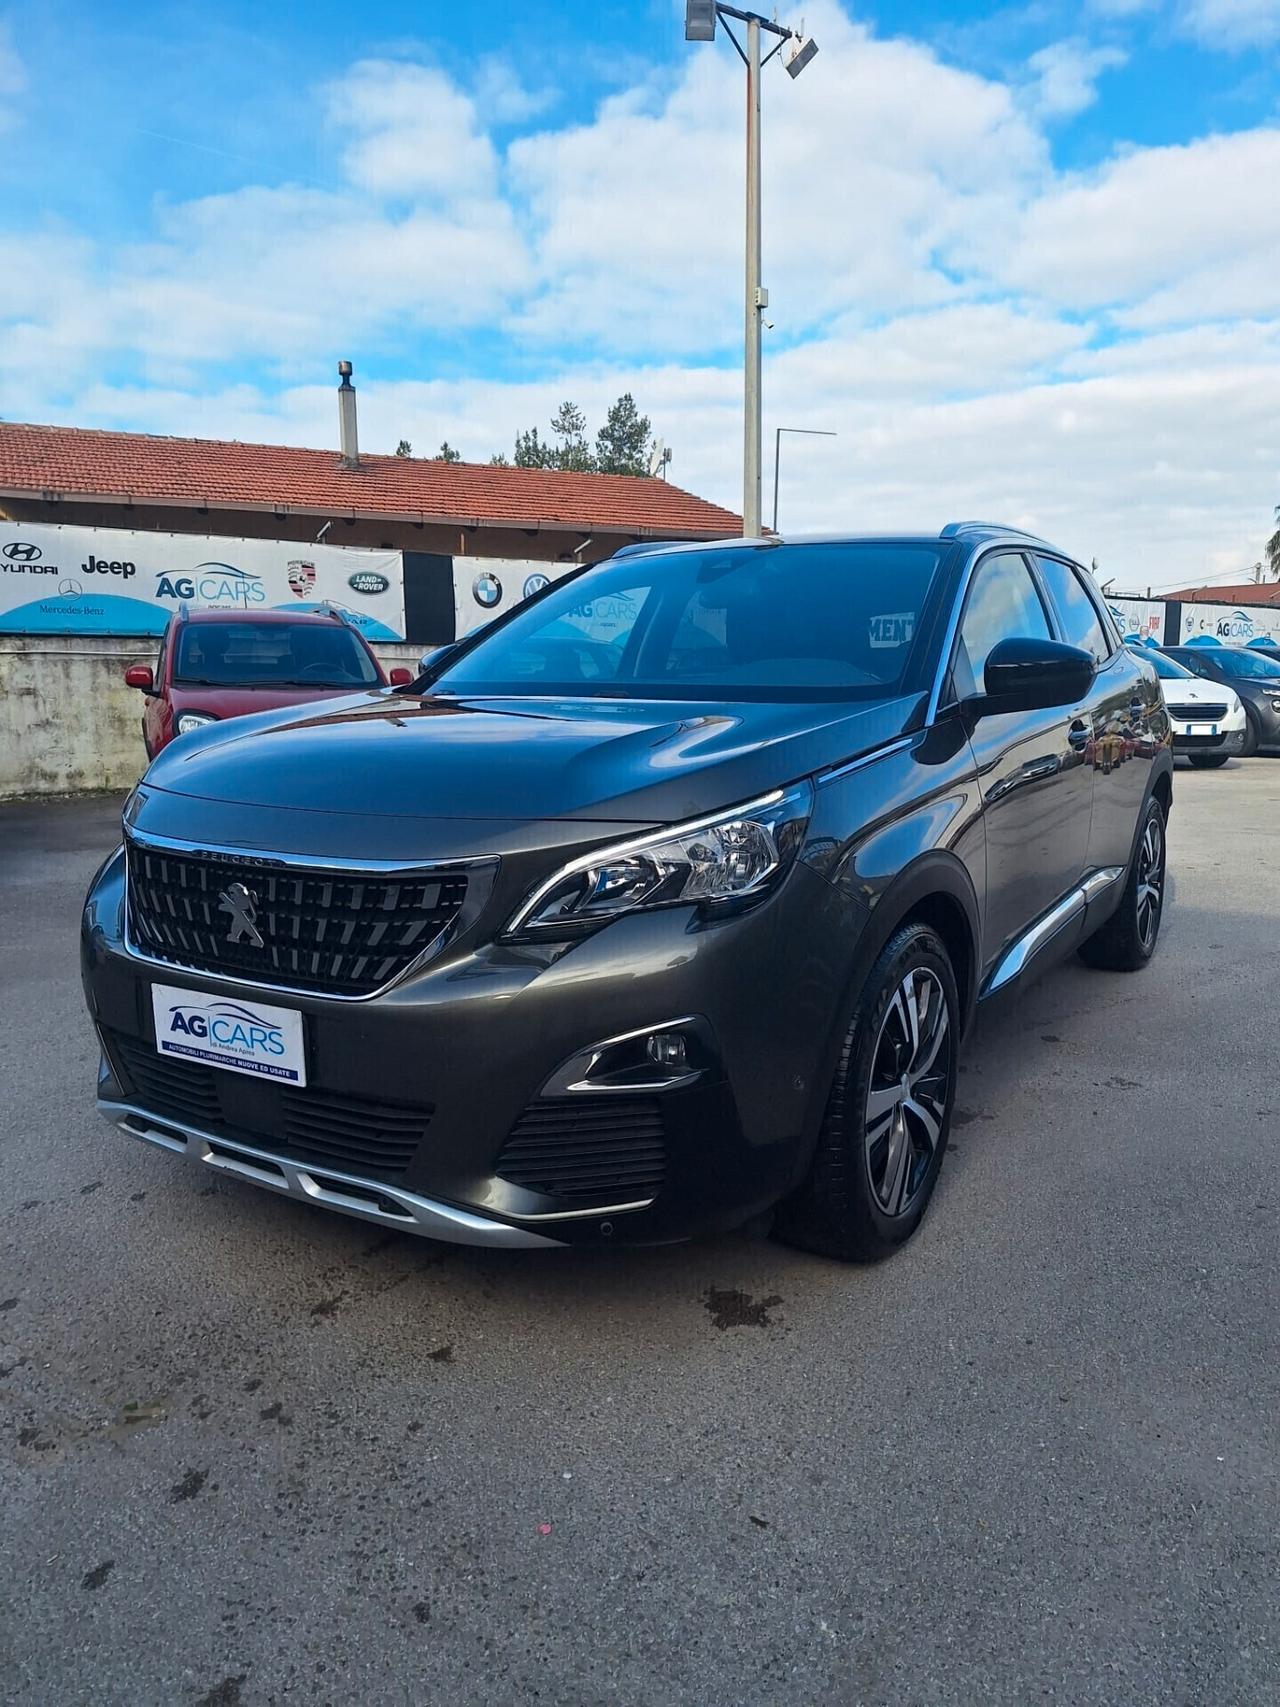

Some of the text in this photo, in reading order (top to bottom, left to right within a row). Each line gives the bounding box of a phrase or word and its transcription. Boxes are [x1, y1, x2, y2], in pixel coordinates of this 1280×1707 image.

[0, 564, 58, 575] YUNDAI
[81, 555, 136, 579] Jeep
[356, 575, 377, 583] LAND
[156, 577, 266, 602] AG CARS
[40, 605, 105, 616] Mercedes-Benz
[596, 601, 637, 620] CARS
[1216, 622, 1230, 637] AG
[1230, 623, 1254, 637] CARS
[170, 1011, 285, 1055] AG CARS
[168, 1044, 199, 1057] AUTOMOBILI
[200, 1051, 237, 1065] PLURIMARCHE
[237, 1060, 259, 1070] NUOVE
[269, 1067, 290, 1077] USATE
